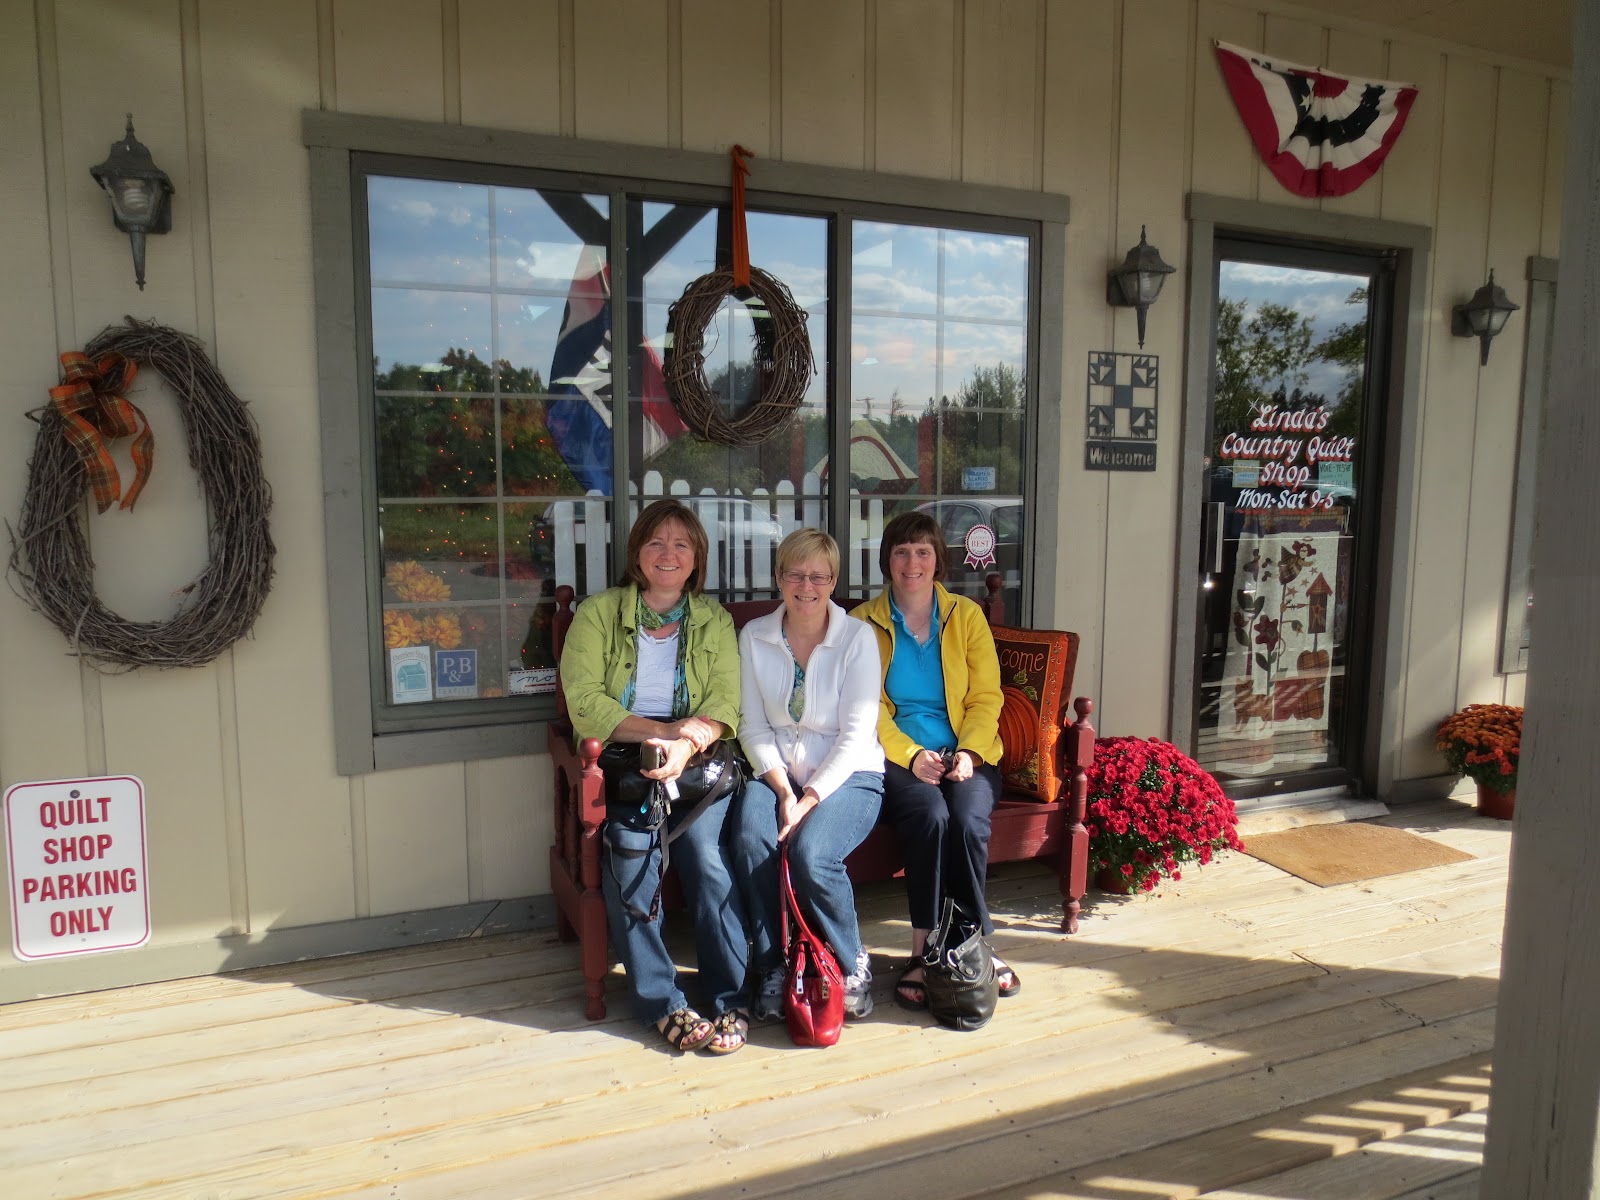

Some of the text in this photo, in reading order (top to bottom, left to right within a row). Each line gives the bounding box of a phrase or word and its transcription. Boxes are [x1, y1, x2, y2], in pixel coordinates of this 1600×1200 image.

[1251, 403, 1330, 432] Linda's
[1090, 447, 1154, 466] Welcome
[1220, 432, 1354, 466] Country Quilt
[1259, 461, 1310, 491] Shop
[1310, 489, 1335, 511] 9-5
[971, 540, 990, 548] BEST
[999, 648, 1044, 671] come
[517, 674, 556, 683] mo
[39, 797, 112, 830] QUILT
[43, 834, 113, 865] SHOP
[22, 868, 137, 903] PARKING
[50, 906, 114, 937] ONLY
